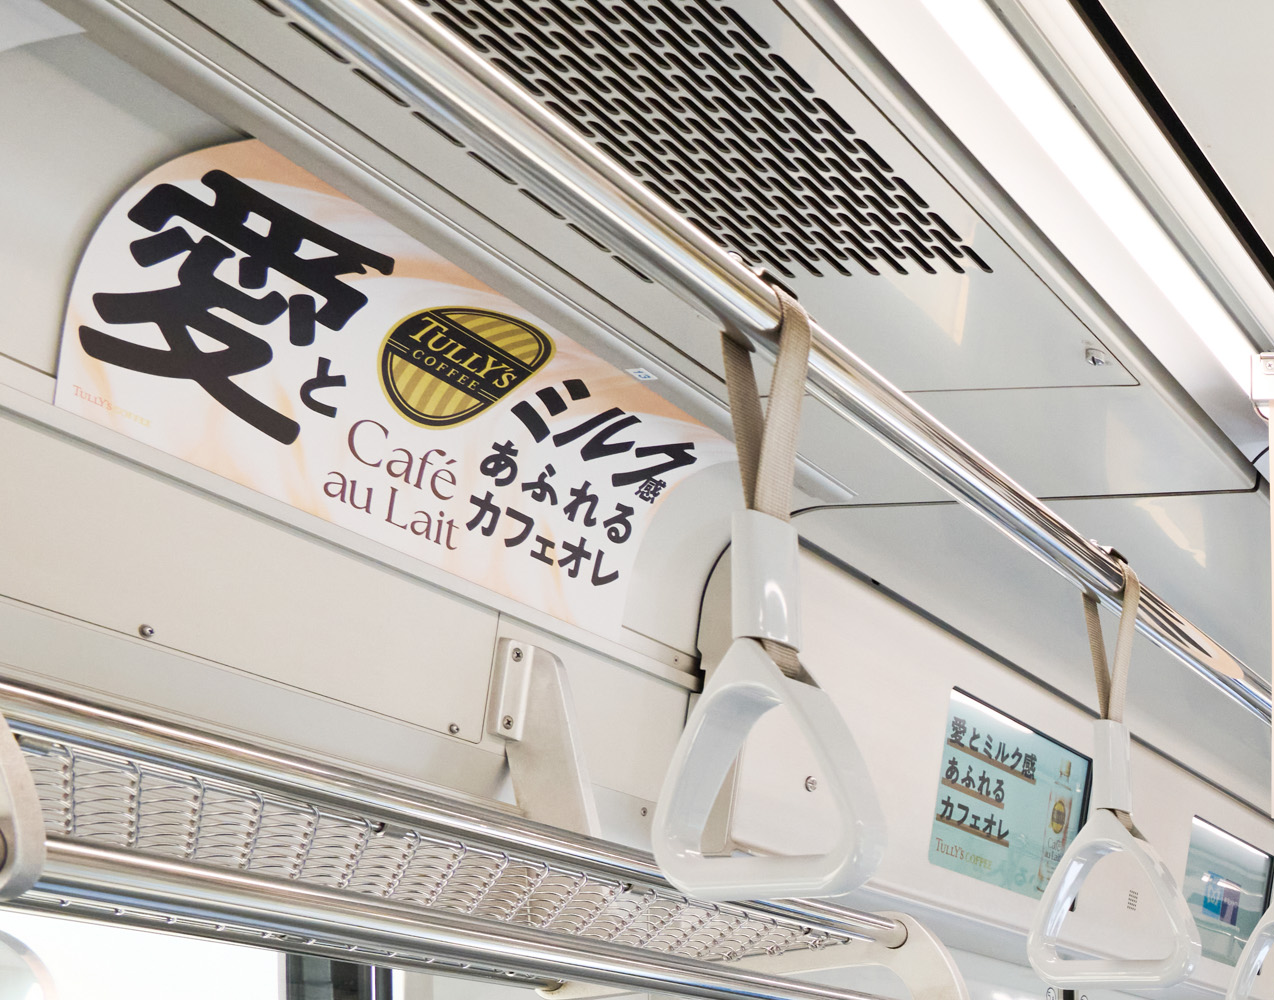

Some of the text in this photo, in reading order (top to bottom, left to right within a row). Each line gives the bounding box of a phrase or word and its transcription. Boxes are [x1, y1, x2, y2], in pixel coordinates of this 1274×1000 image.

[405, 316, 518, 390] TULLY'S
[411, 347, 482, 393] COFFEE
[73, 385, 112, 410] TULLY'S
[347, 420, 458, 500] Café
[323, 472, 459, 551] au Lait
[480, 441, 633, 543] あふれる
[466, 490, 619, 585] カフェオレ
[950, 716, 1037, 779] 愛とミルク感
[945, 757, 1005, 803] あふれる
[940, 796, 1009, 840] カフェオレ
[936, 838, 992, 870] TULLY'S COFFEE
